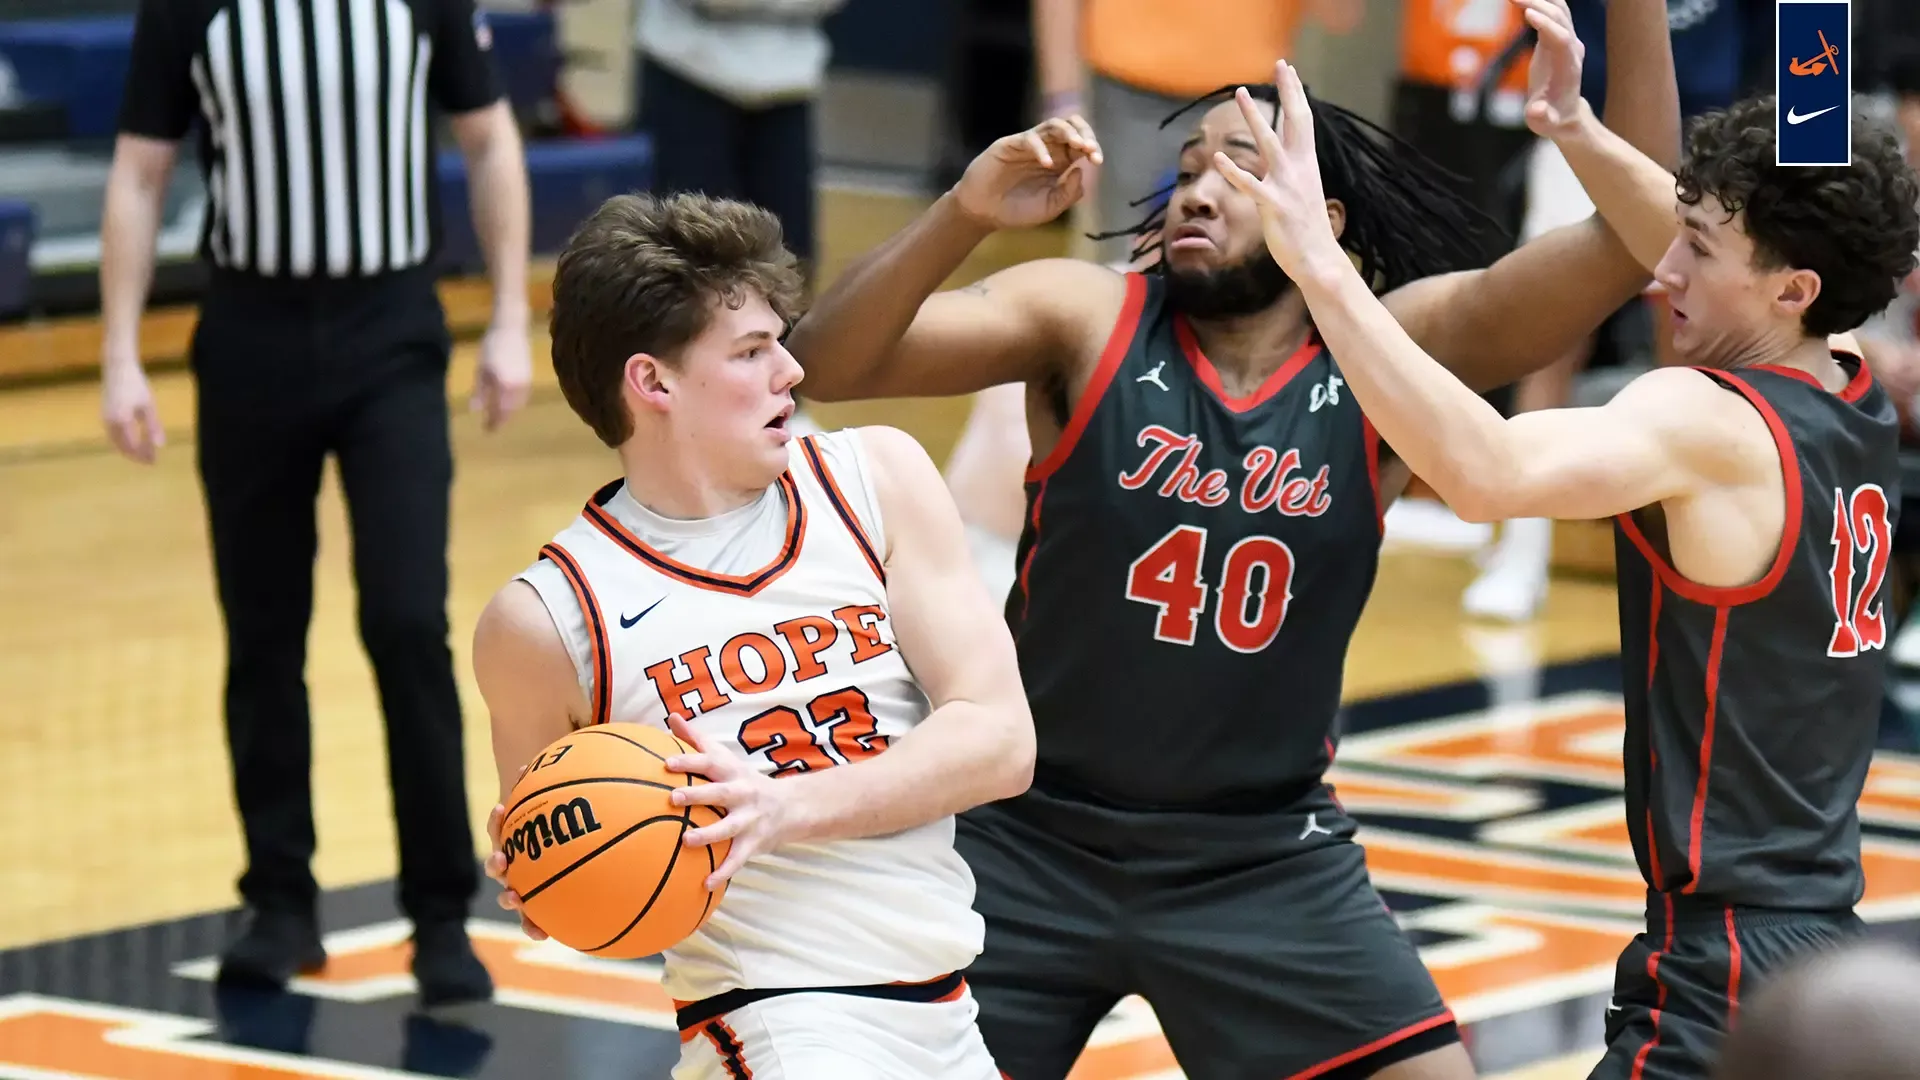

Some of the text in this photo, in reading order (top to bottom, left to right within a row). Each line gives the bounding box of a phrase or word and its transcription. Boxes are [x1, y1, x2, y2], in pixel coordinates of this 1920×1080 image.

[1119, 425, 1331, 517] The Vet
[1125, 524, 1294, 653] 40
[1827, 483, 1892, 657] 12
[644, 604, 892, 729] HOPE
[738, 685, 889, 779] 32
[502, 797, 601, 871] Wilso
